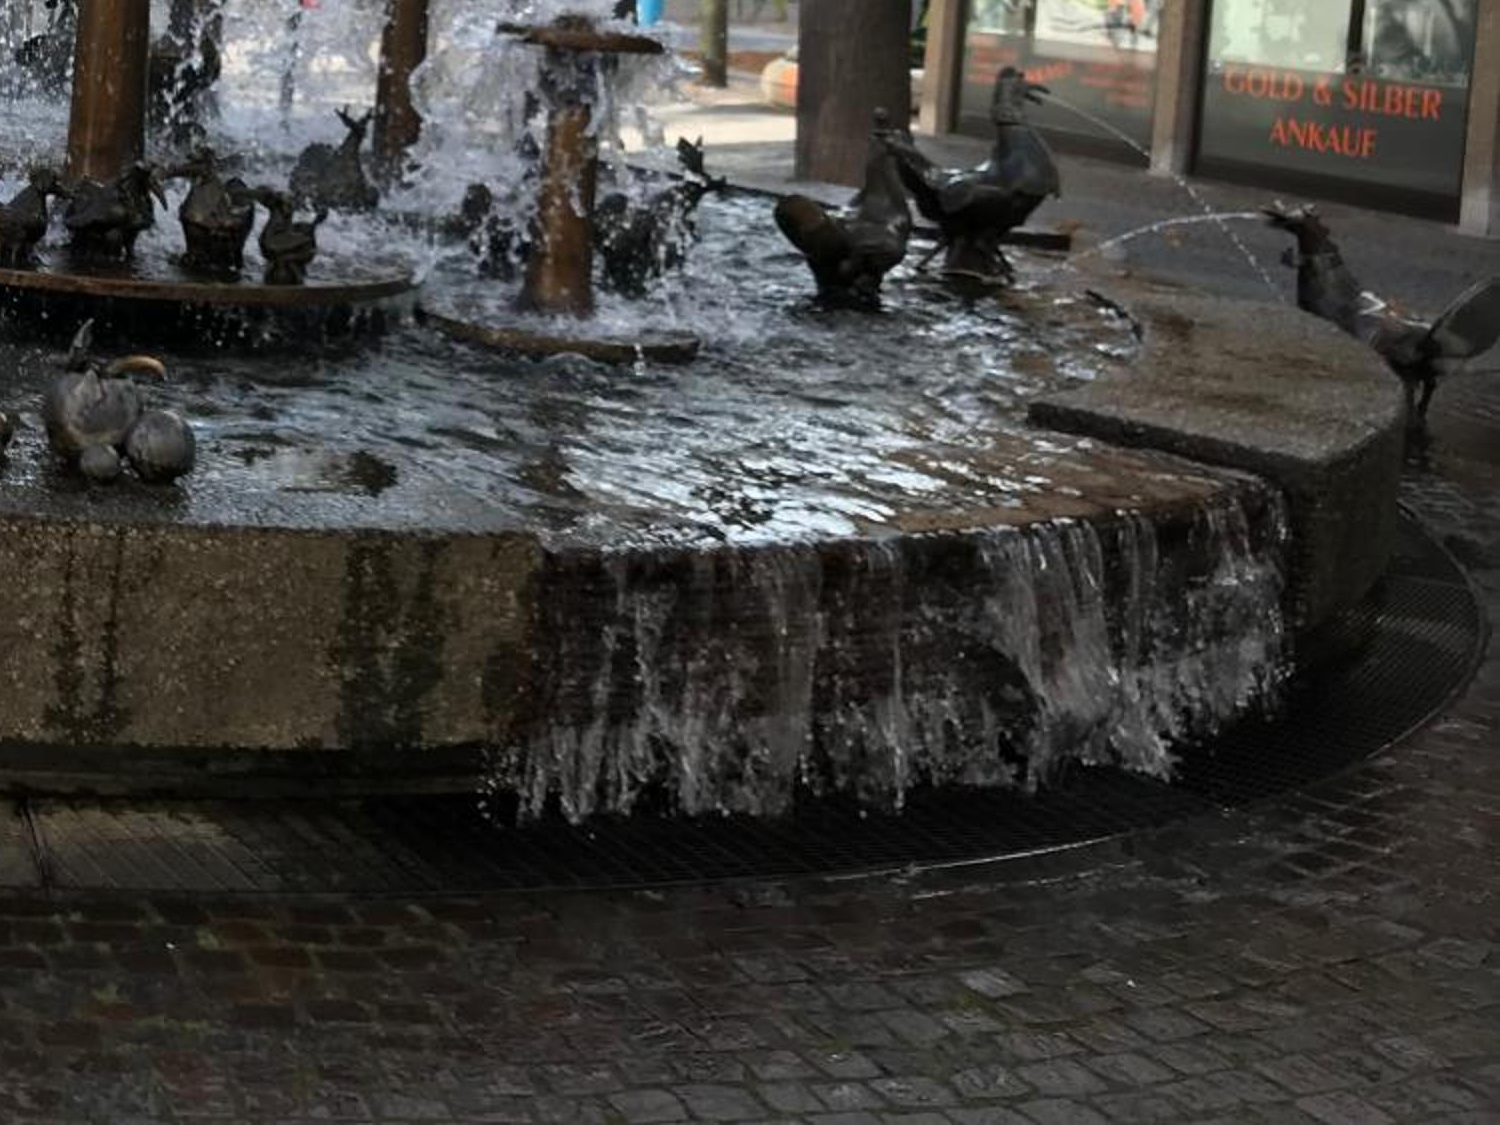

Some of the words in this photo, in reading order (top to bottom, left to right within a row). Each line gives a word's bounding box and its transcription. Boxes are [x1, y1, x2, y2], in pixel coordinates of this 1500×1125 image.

[1224, 65, 1303, 100] GOLD
[1313, 78, 1332, 106] &
[1342, 78, 1443, 120] SILBER
[1270, 118, 1377, 157] ANKAUF
